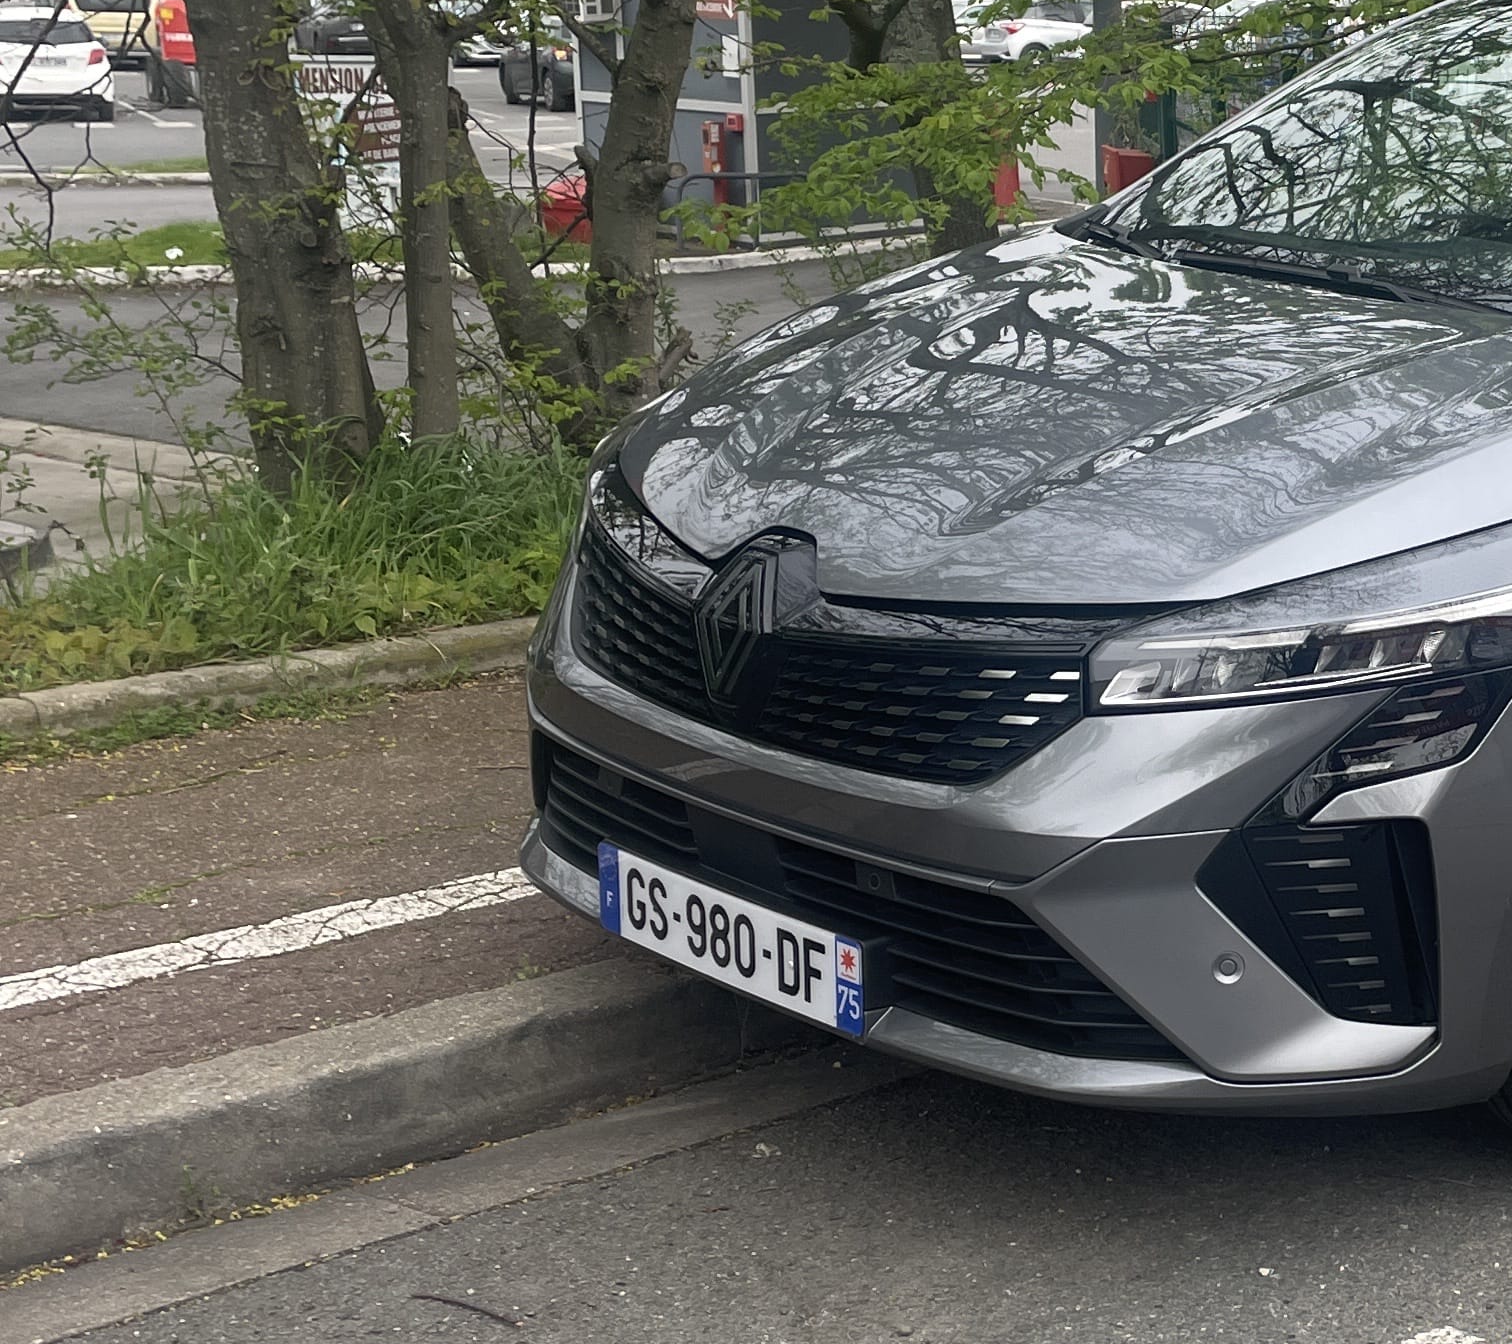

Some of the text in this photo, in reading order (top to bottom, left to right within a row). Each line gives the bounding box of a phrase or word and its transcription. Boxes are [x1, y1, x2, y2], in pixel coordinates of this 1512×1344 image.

[606, 890, 614, 906] F
[626, 867, 826, 1003] GS-980-DF
[838, 984, 860, 1020] 75
